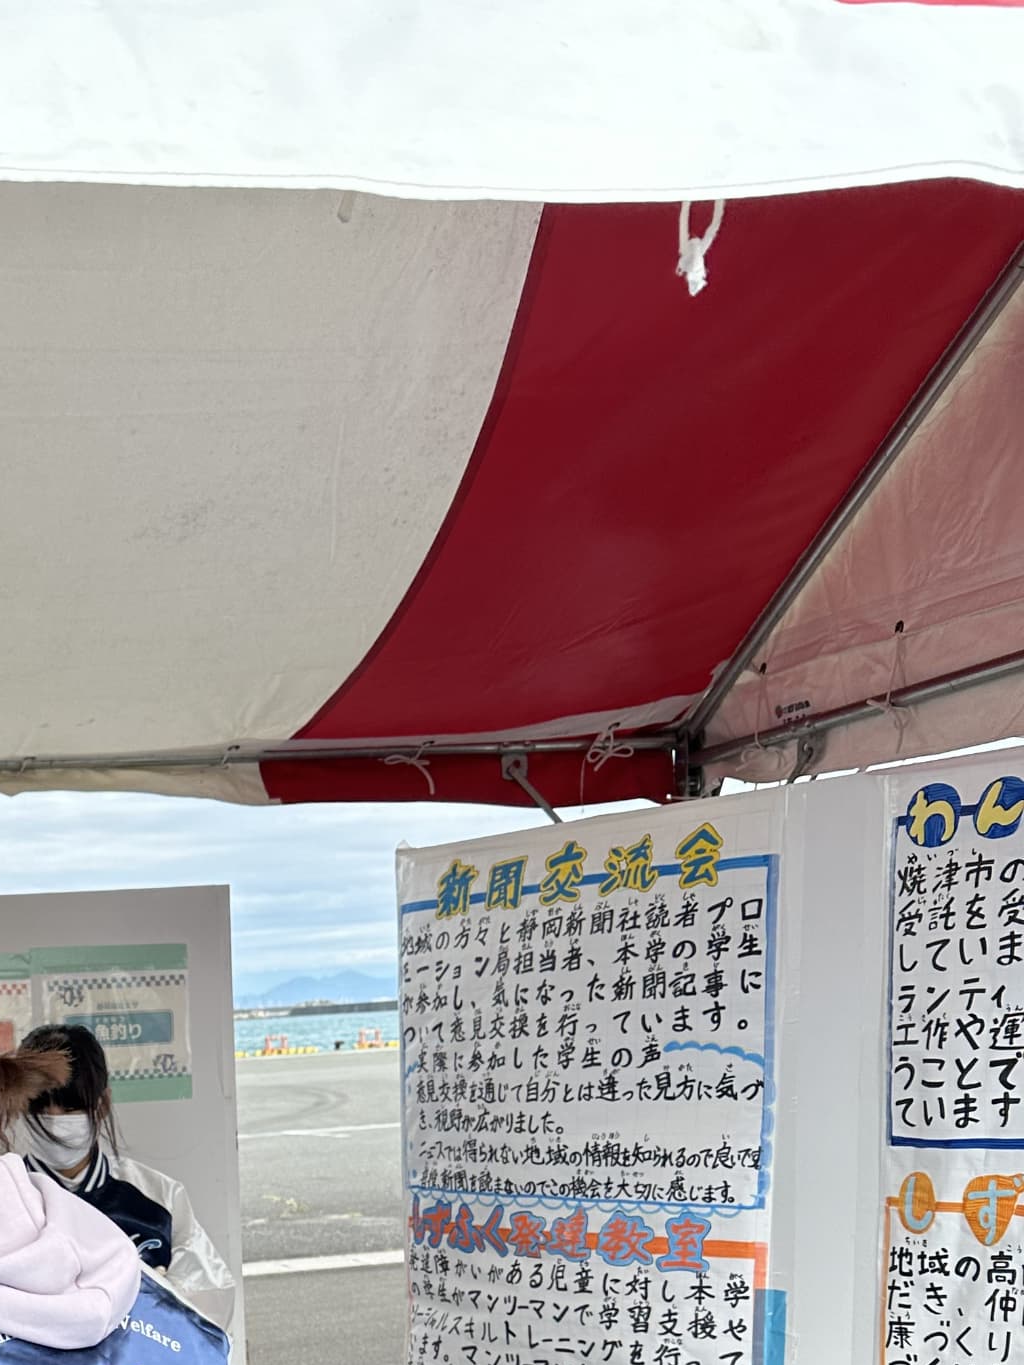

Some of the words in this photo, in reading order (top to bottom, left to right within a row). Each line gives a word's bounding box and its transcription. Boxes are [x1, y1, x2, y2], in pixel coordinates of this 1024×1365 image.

[435, 822, 723, 920] 新聞交流会
[898, 853, 1024, 897] 焼津市の
[899, 931, 1023, 972] していま
[898, 978, 1007, 1015] ランティ
[893, 1013, 1024, 1051] 工作や運
[894, 1052, 1024, 1090] うことで
[895, 1092, 1021, 1128] ています
[885, 1316, 1012, 1362] 康づくり
